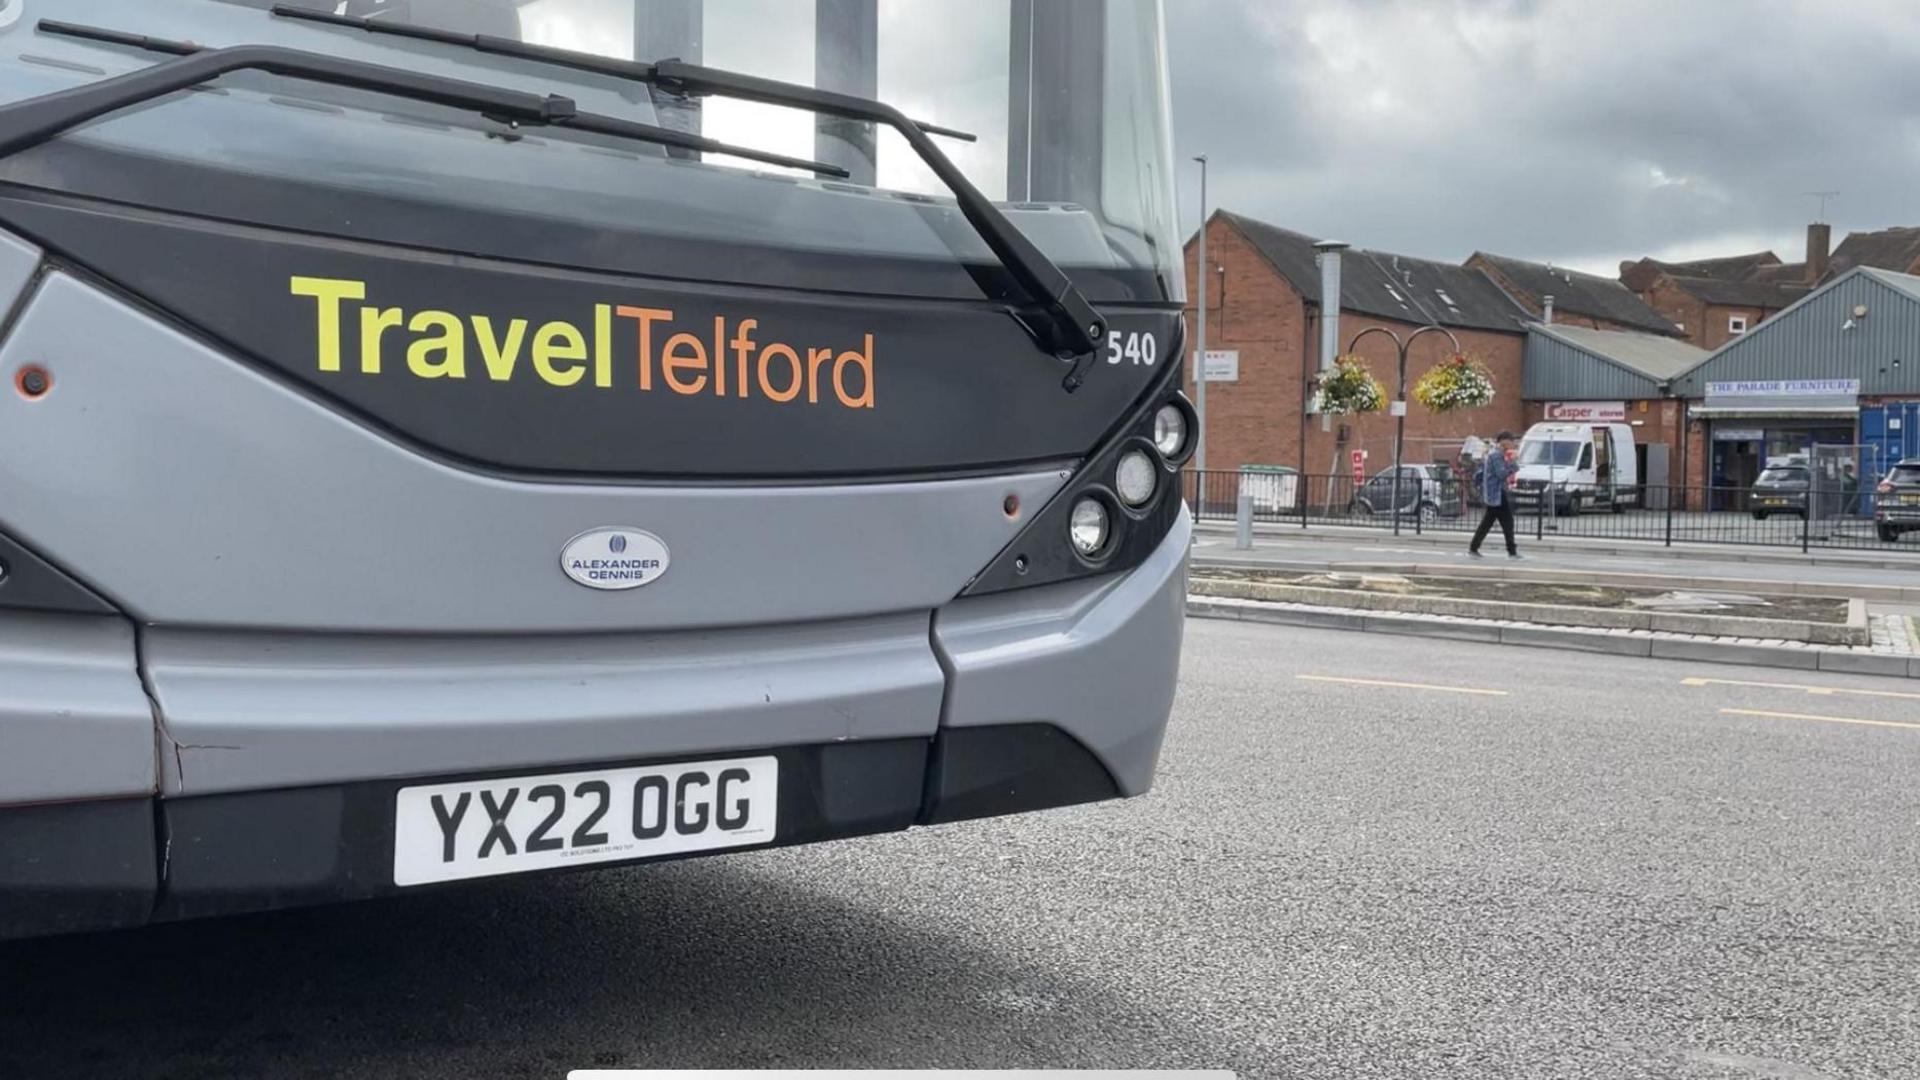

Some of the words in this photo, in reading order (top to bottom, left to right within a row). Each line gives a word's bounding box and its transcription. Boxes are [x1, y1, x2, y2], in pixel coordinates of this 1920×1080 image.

[1107, 330, 1156, 366] 540
[1712, 383, 1732, 392] THE
[1737, 382, 1781, 391] PARADE
[1785, 380, 1854, 391] FURNITURE
[572, 559, 660, 569] ALEXANDER
[588, 570, 643, 580] DENNIS
[430, 780, 611, 862] YX22
[631, 767, 751, 840] OGG
